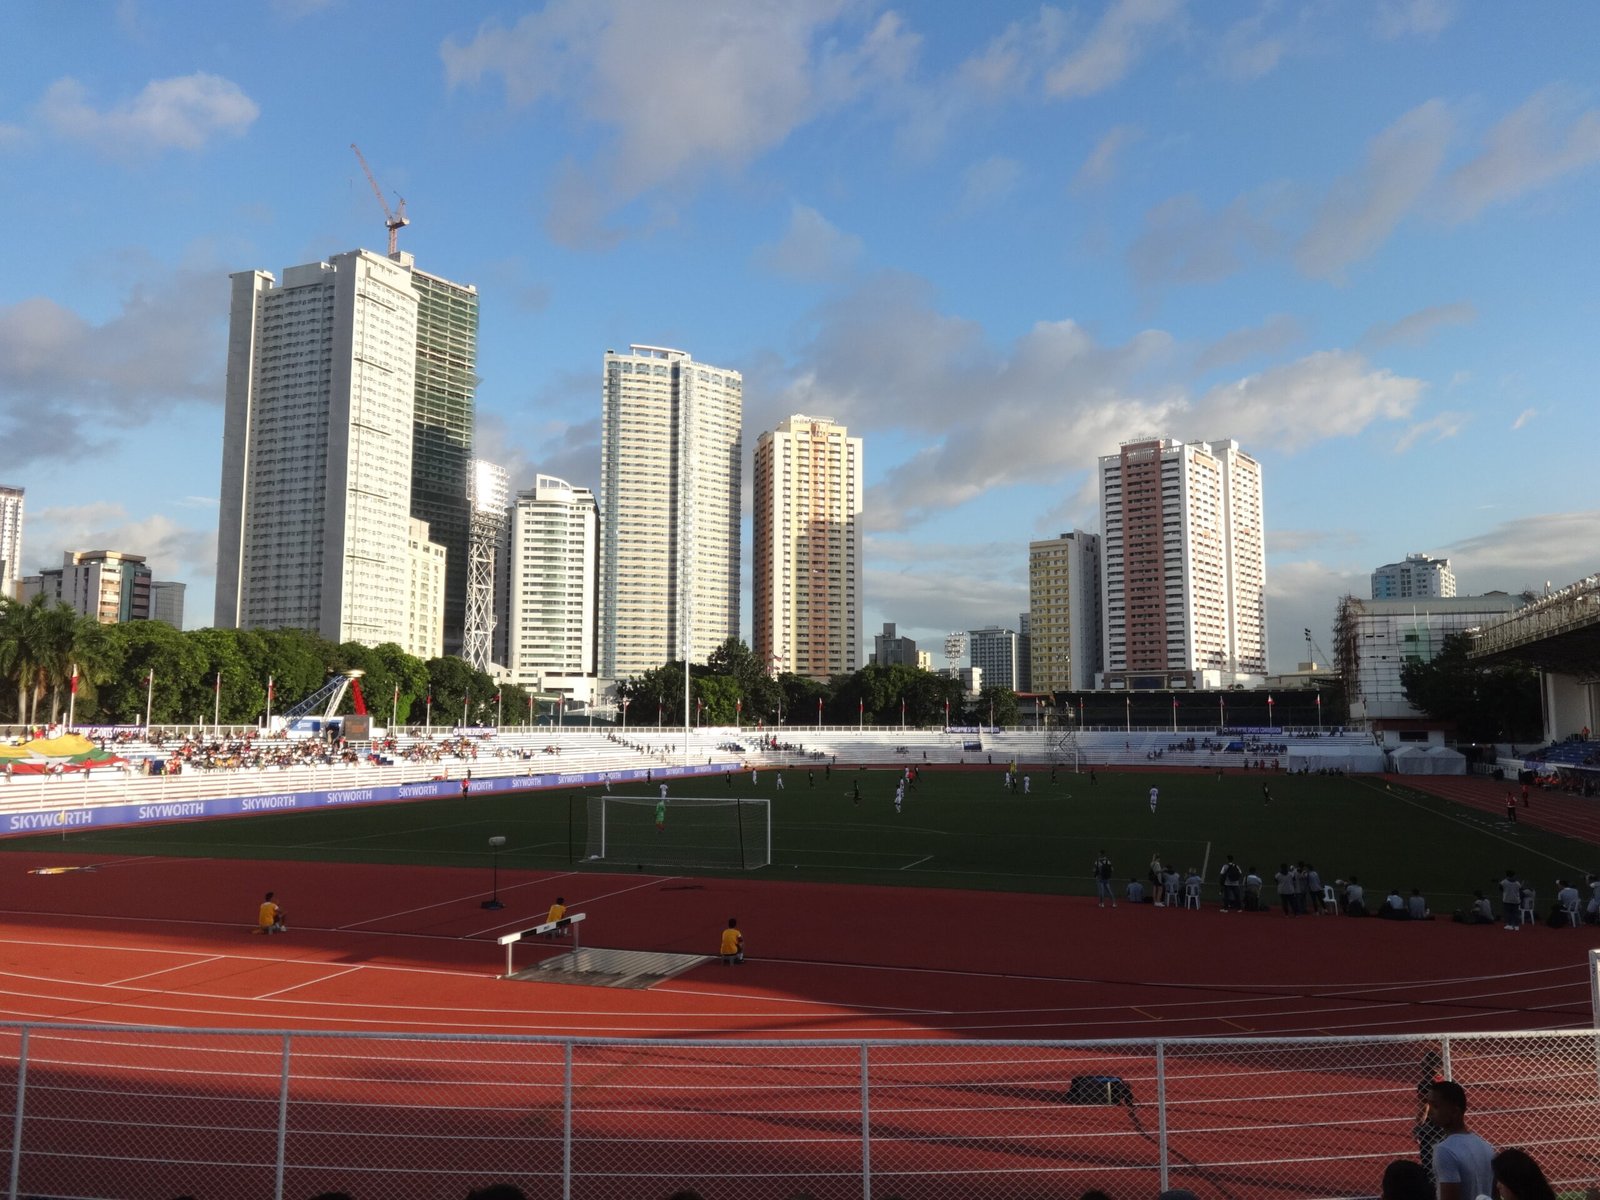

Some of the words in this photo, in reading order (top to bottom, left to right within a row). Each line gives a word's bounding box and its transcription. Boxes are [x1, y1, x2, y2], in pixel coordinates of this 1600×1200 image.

[512, 777, 542, 788] SKYWORTH
[327, 790, 373, 803] SKYWORTH
[398, 785, 437, 797] SKYWORTH
[242, 795, 296, 810] SKYWORTH
[138, 802, 204, 819] SKYWORTH
[10, 810, 92, 830] SKYWORTH
